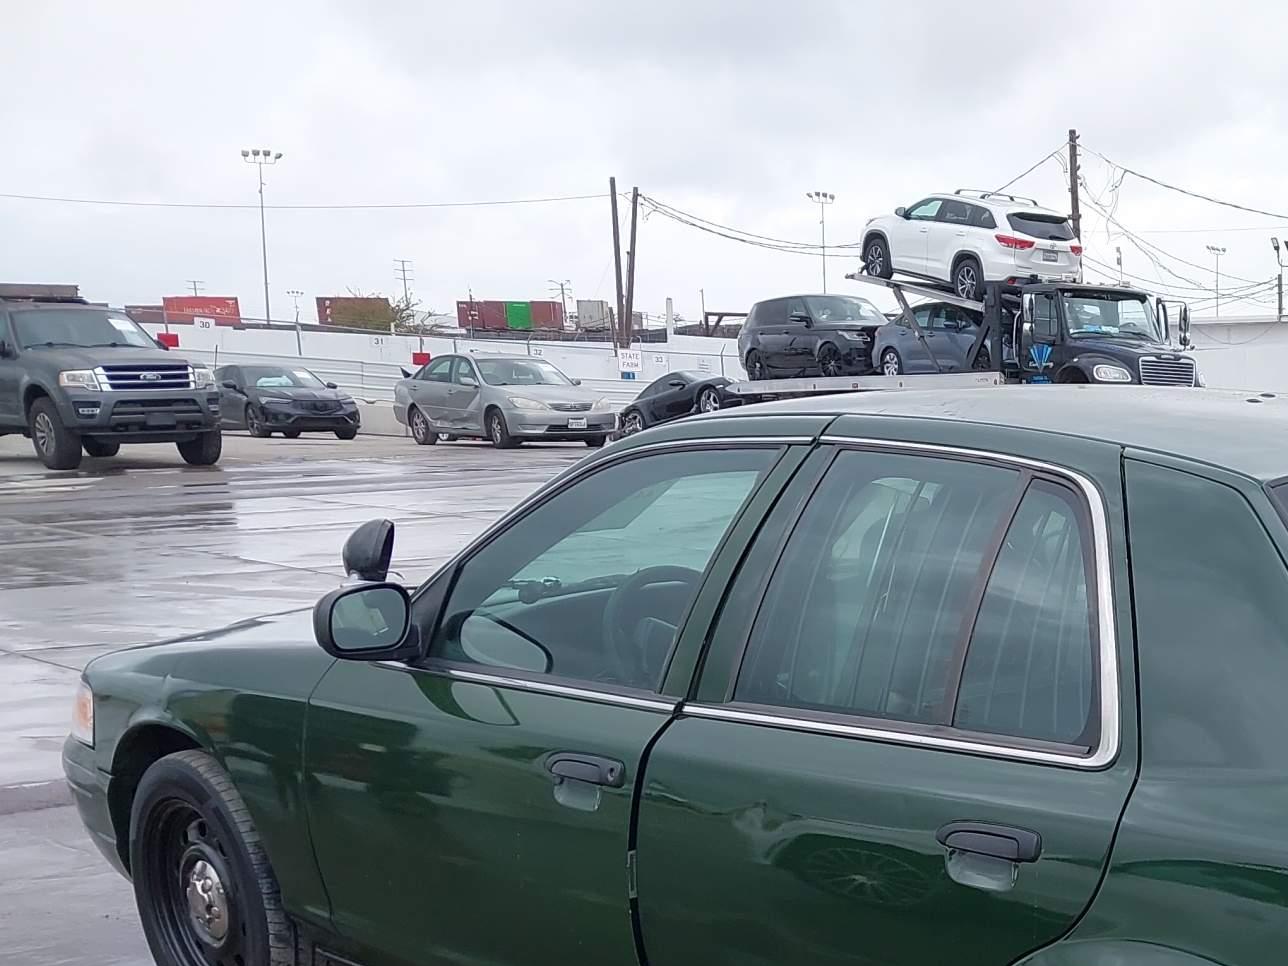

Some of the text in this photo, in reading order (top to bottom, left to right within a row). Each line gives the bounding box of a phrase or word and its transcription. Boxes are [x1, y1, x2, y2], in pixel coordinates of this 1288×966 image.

[199, 320, 211, 329] 30
[374, 337, 384, 345] 31
[533, 348, 543, 356] 32
[620, 352, 640, 360] STATE
